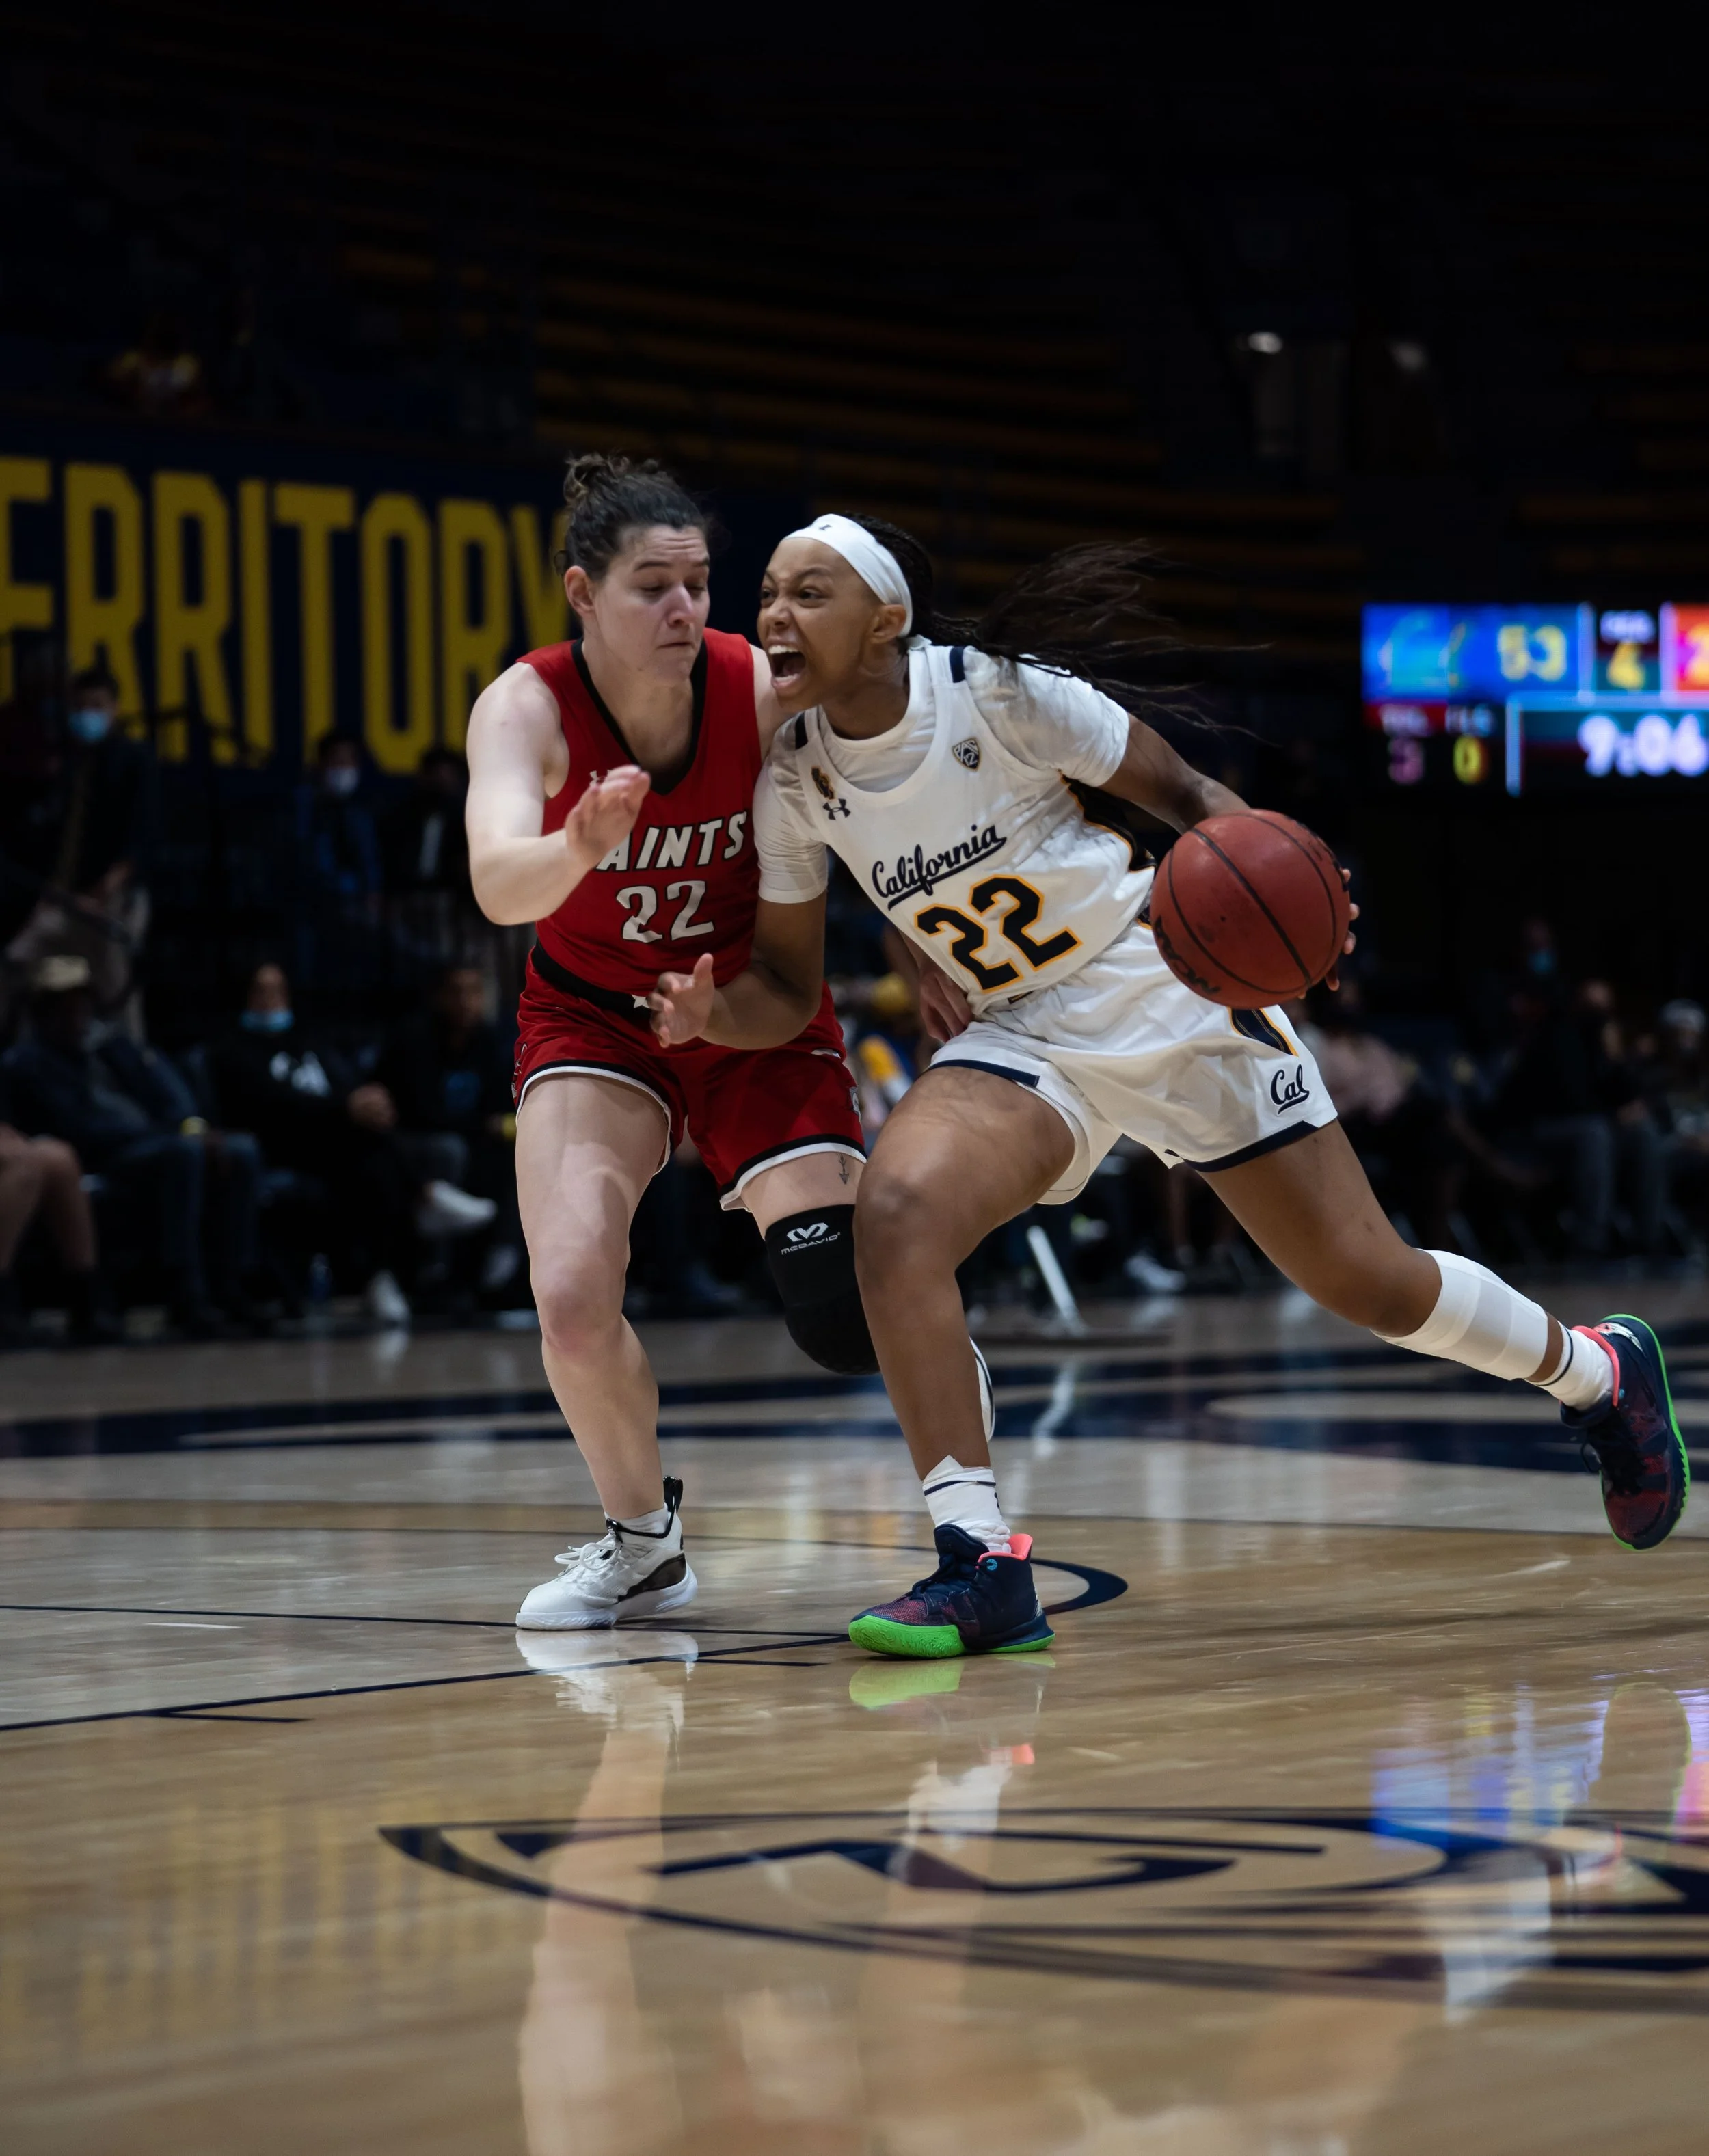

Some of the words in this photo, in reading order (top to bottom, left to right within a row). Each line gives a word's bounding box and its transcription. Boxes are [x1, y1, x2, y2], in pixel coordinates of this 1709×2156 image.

[1497, 624, 1567, 682] 53
[595, 811, 747, 872] AINTS
[872, 824, 1007, 911] California
[616, 880, 714, 943] 22
[914, 874, 1083, 993] 22
[1270, 1064, 1310, 1115] Cal
